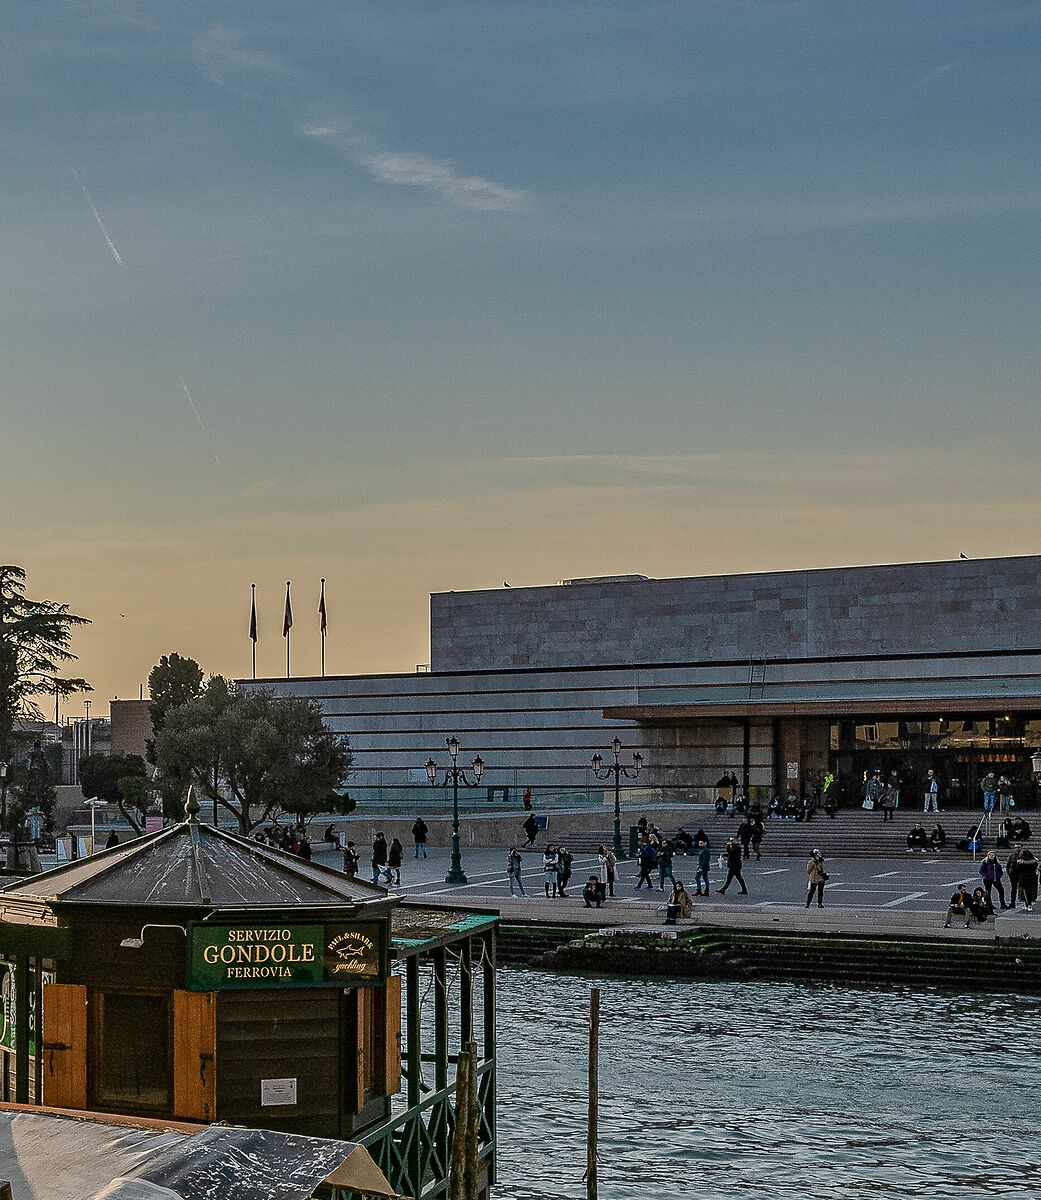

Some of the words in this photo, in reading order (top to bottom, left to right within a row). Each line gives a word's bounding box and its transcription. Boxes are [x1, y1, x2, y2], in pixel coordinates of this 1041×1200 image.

[228, 929, 292, 942] SERVIZIO
[203, 943, 315, 964] GONDOLE
[227, 966, 292, 979] FERROVIA
